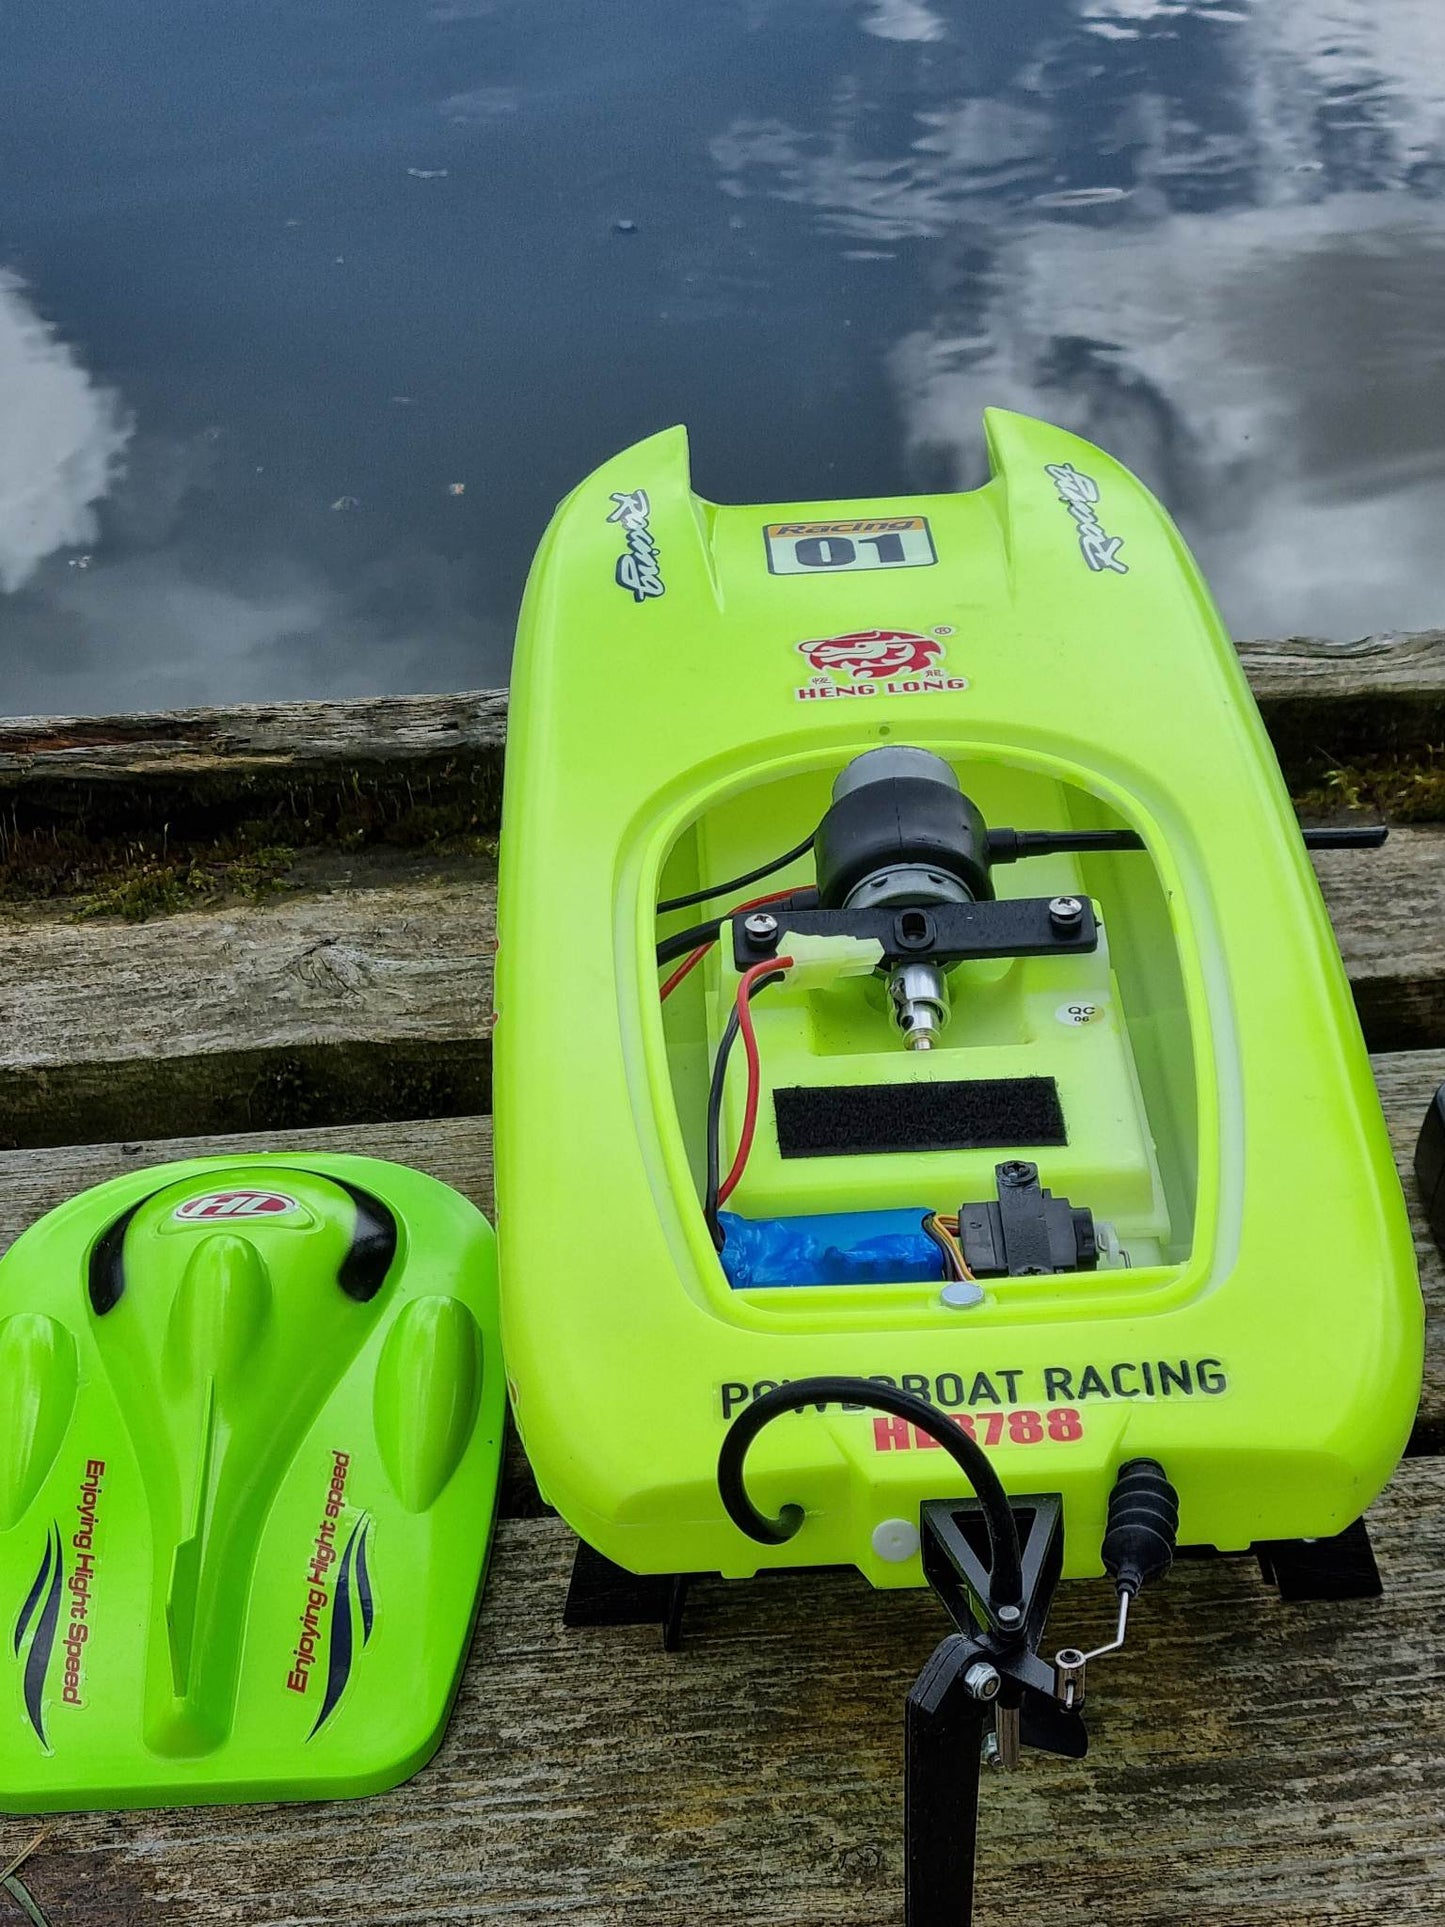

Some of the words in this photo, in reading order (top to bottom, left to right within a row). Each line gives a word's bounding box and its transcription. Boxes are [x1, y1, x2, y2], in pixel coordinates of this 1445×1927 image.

[606, 488, 665, 603] Racing
[776, 520, 914, 535] Racing
[795, 533, 906, 567] 01
[1044, 462, 1129, 574] Racing
[798, 684, 875, 699] HENG
[887, 679, 964, 693] LONG
[1067, 1006, 1096, 1015] QC
[721, 1369, 1024, 1420] PBOAT
[1043, 1359, 1227, 1401] RACING
[73, 1459, 105, 1550] Enjoying
[68, 1552, 95, 1619] Hight
[286, 1588, 328, 1694] Enjoying
[307, 1519, 336, 1587] Hight
[324, 1450, 350, 1519] speed
[62, 1621, 88, 1705] Speed
